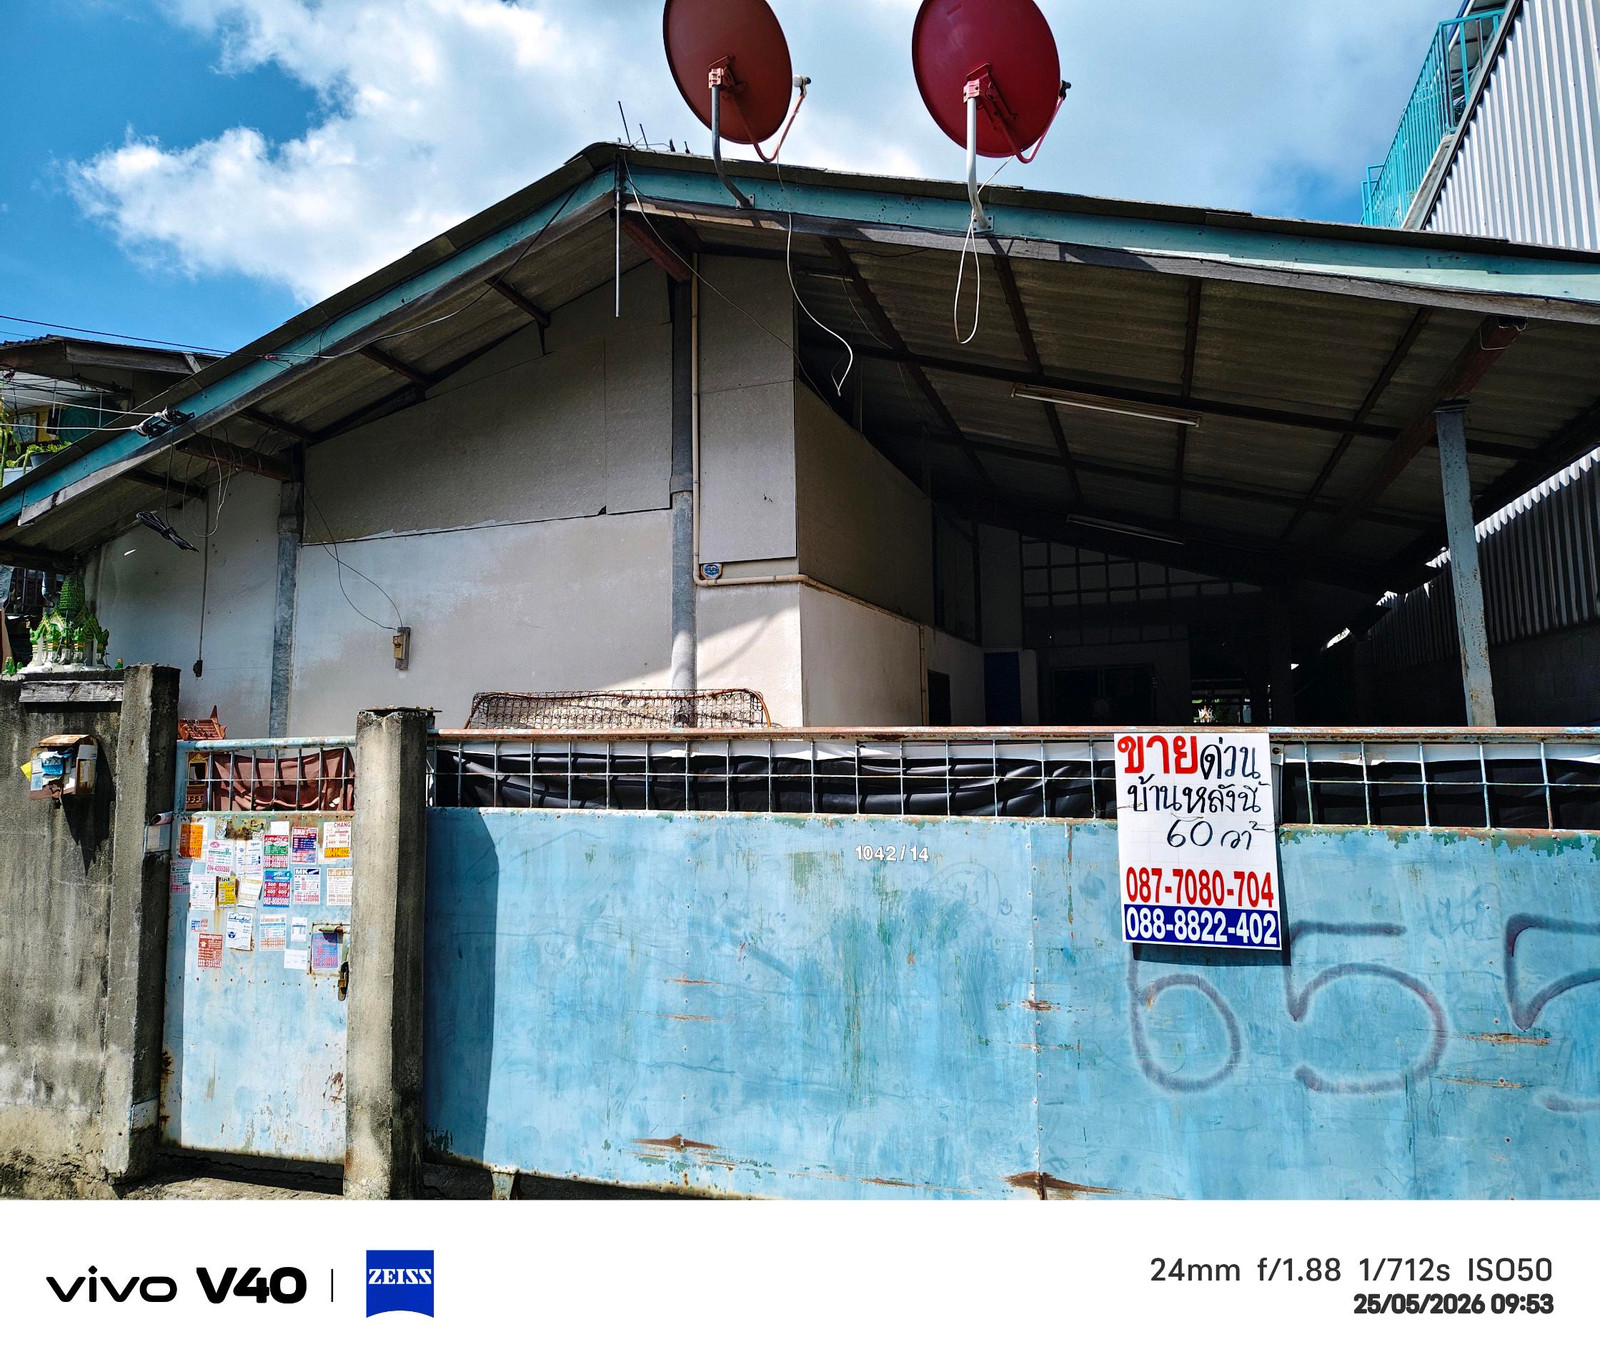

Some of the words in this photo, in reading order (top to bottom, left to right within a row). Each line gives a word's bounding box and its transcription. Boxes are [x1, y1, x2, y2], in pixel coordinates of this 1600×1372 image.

[1166, 819, 1214, 848] 60
[854, 844, 930, 862] 1042/14
[1126, 866, 1274, 908] 087-7080-704
[1126, 906, 1277, 945] 088-8822-402
